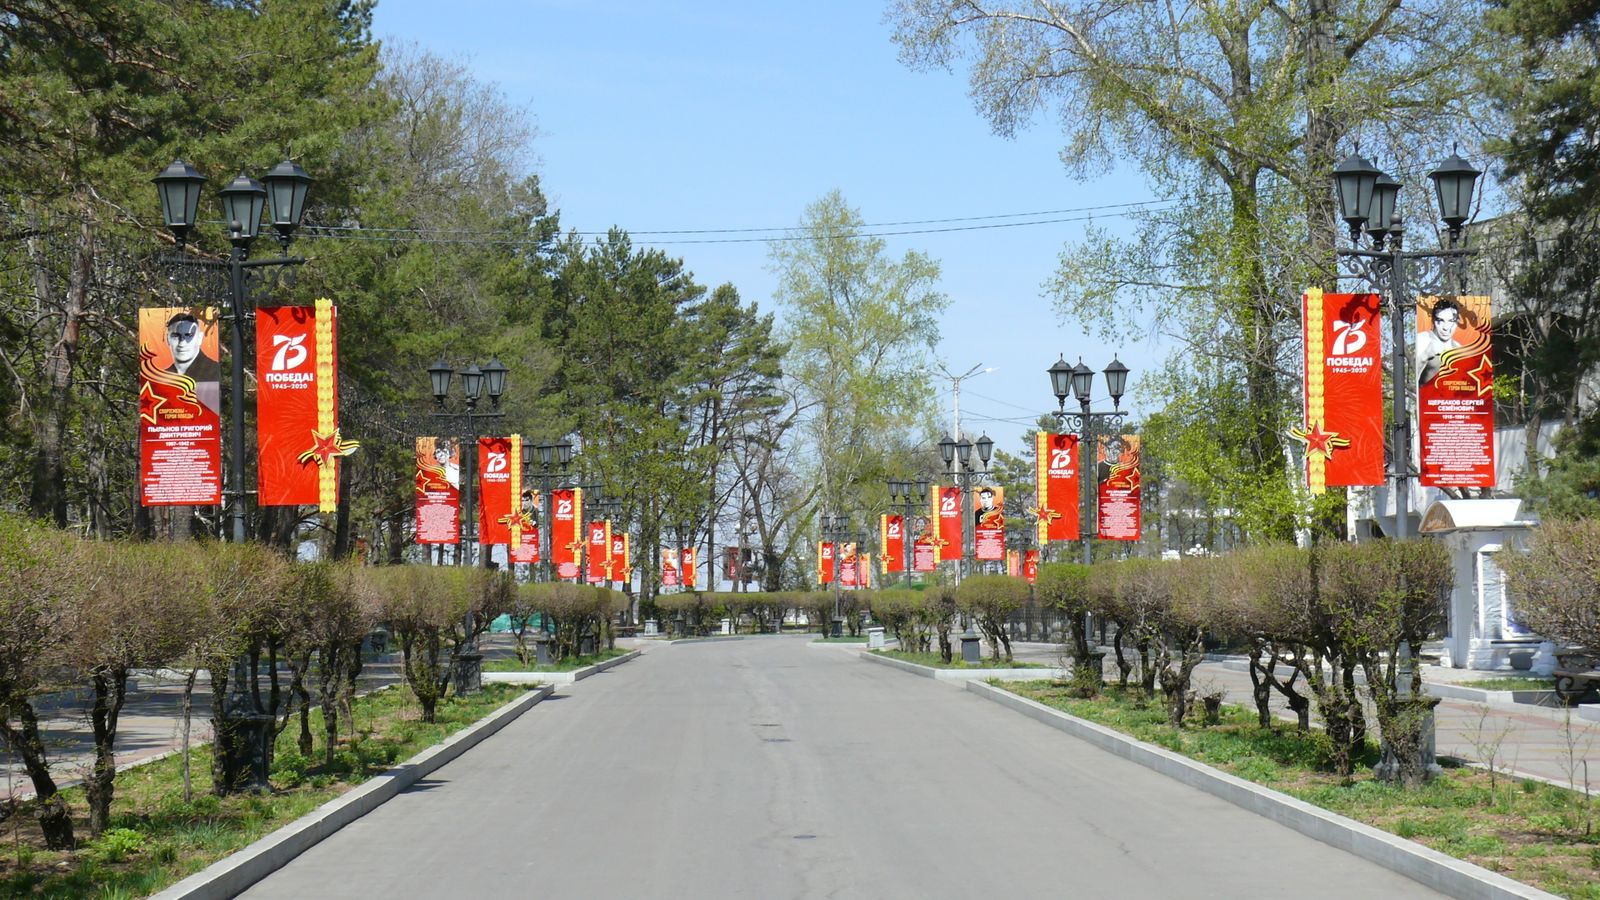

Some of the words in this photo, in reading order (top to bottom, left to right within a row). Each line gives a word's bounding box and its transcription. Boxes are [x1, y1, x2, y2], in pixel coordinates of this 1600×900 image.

[1332, 319, 1367, 355] 75
[272, 333, 307, 370] 75
[1326, 357, 1373, 367] ПОБЕДА!
[265, 373, 314, 383] ПОБЕДА!
[1461, 398, 1484, 406] СЕРГЕЙ
[180, 424, 213, 432] ГРИГОРИЙ
[487, 452, 507, 472] 75
[1051, 448, 1071, 469] 75
[557, 499, 572, 514] 75
